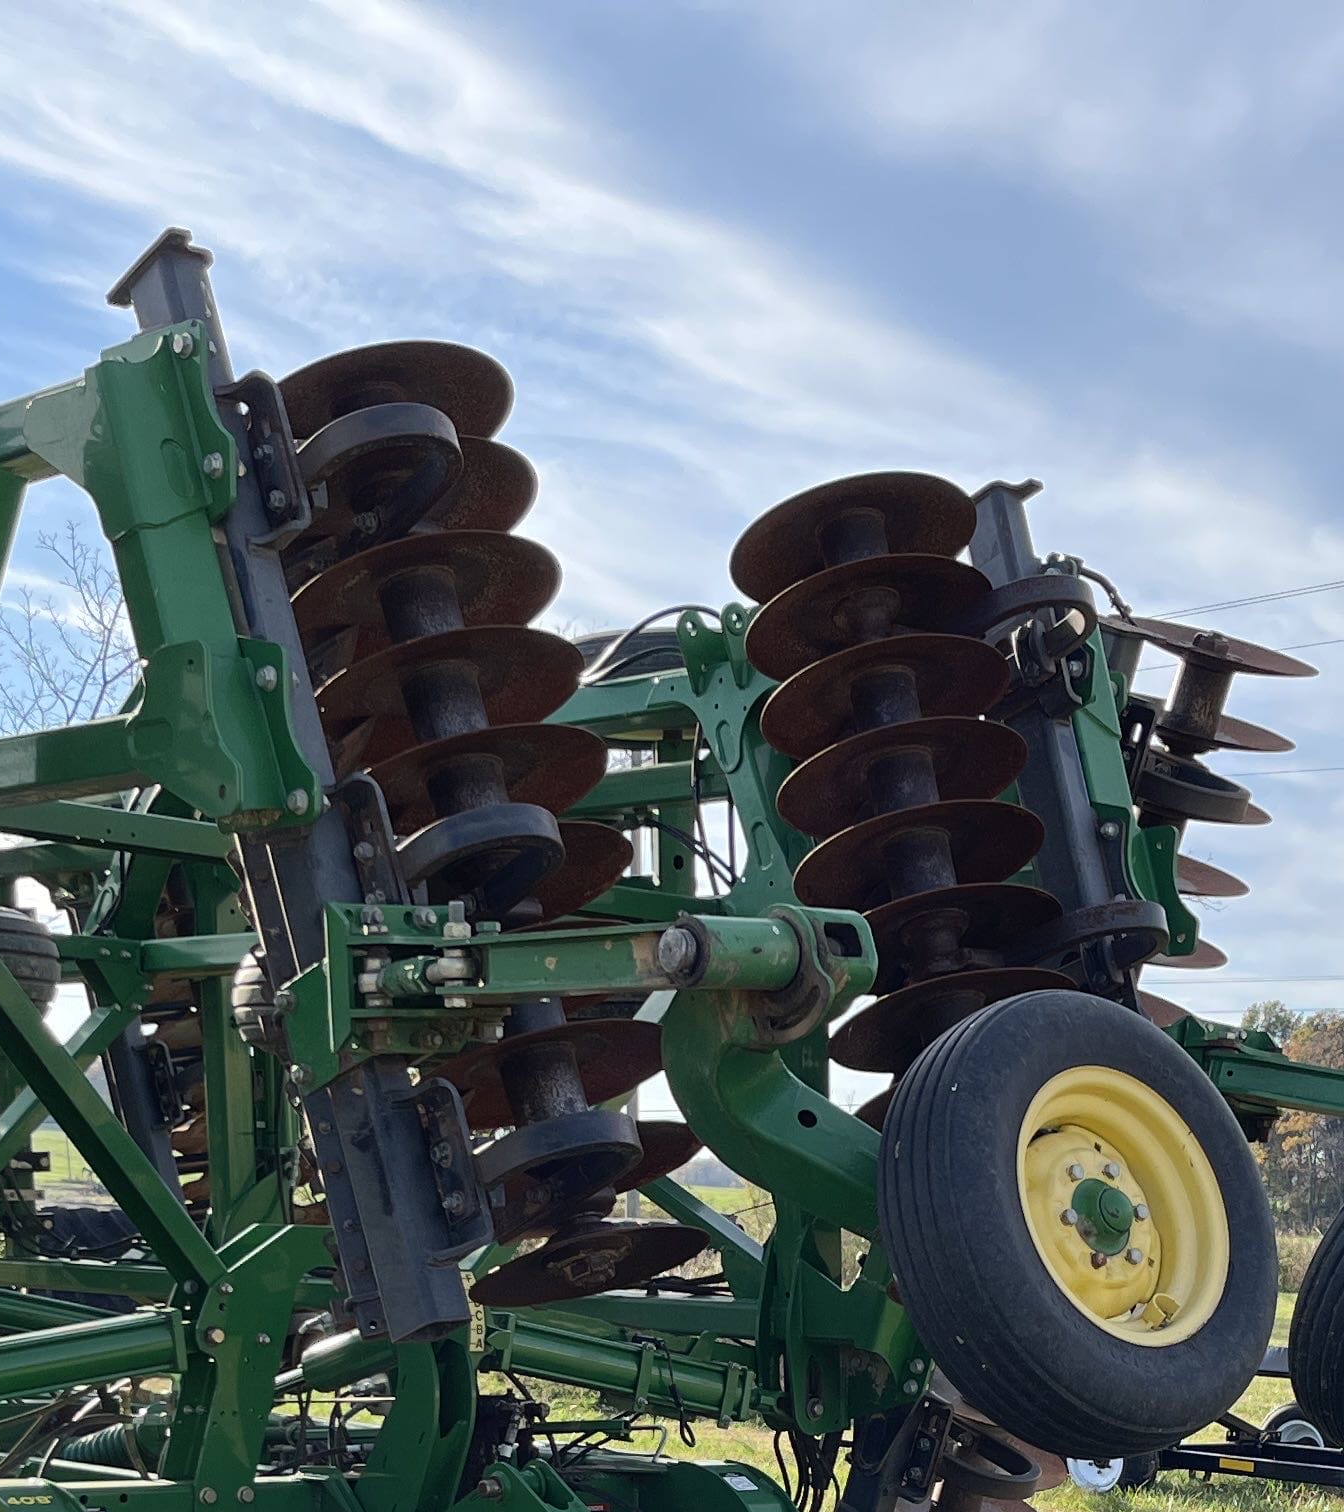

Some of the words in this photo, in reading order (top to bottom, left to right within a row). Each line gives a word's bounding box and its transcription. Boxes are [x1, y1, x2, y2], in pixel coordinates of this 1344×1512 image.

[475, 1310, 483, 1321] C
[476, 1324, 483, 1335] B
[475, 1338, 484, 1349] A
